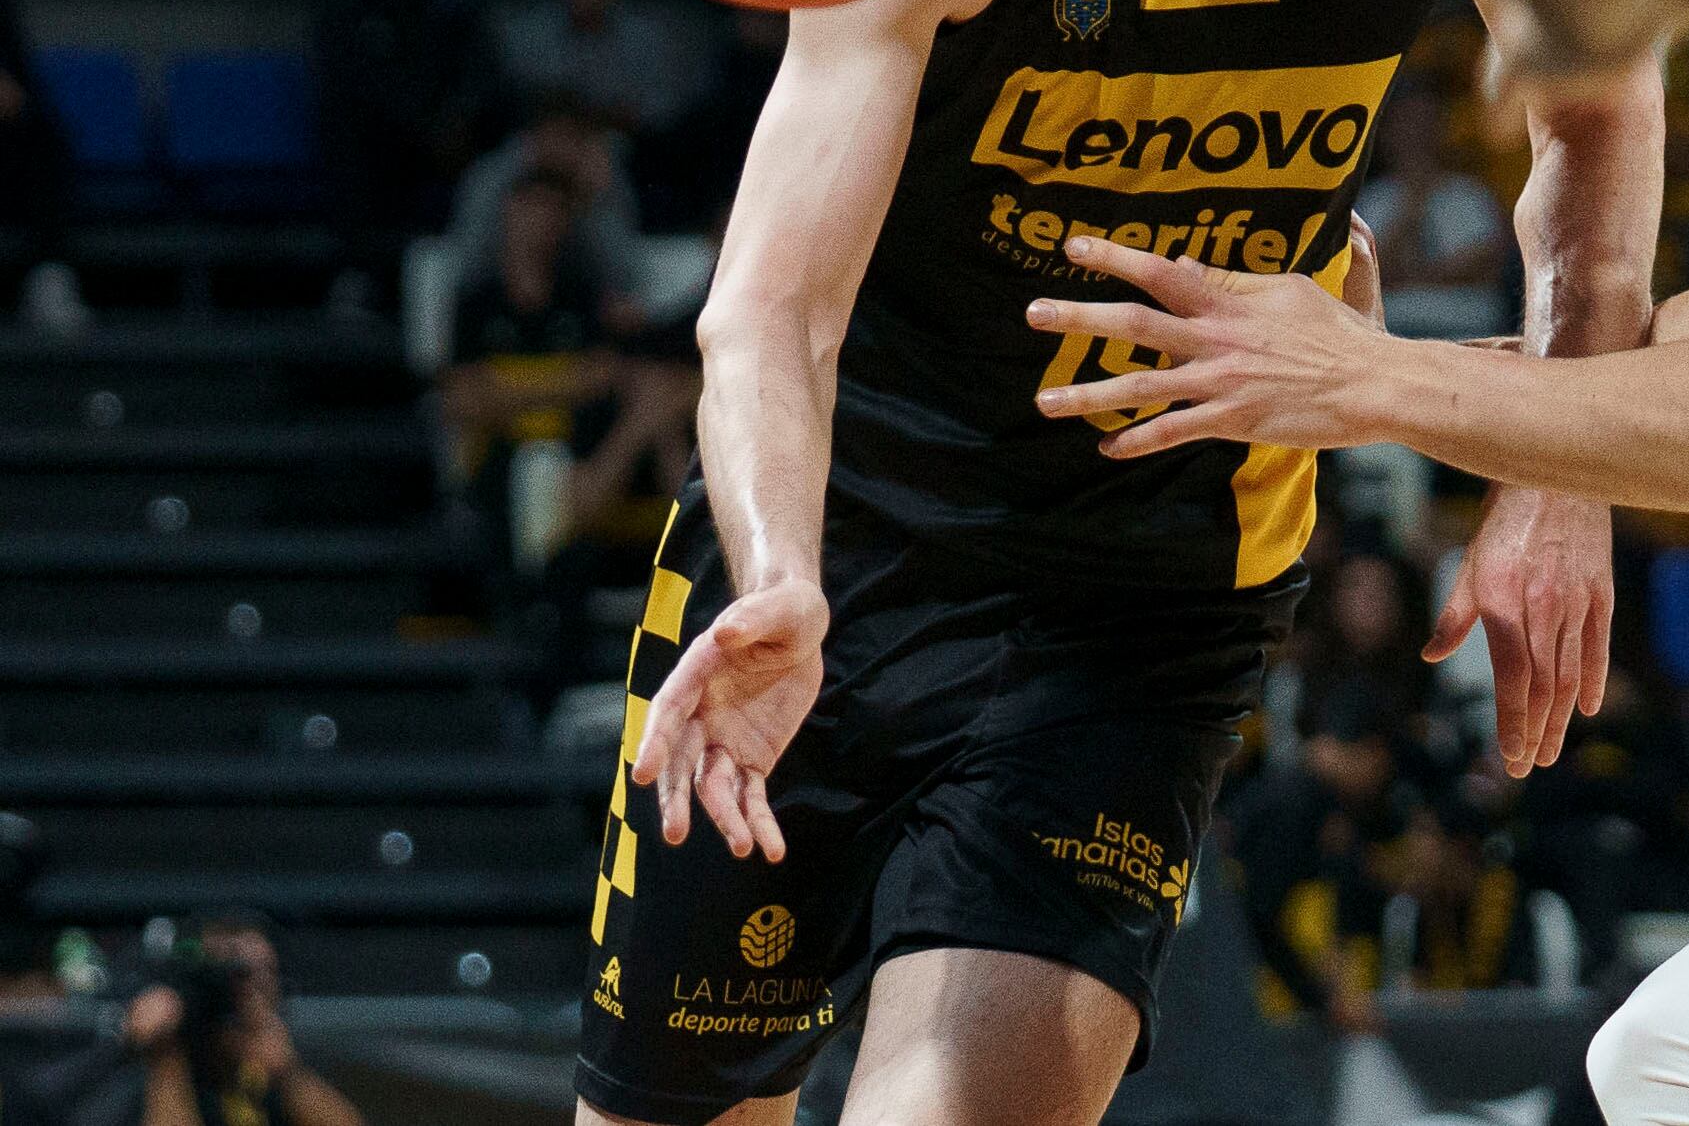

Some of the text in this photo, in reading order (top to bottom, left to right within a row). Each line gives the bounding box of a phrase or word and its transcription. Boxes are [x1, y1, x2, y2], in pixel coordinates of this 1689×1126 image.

[997, 88, 1369, 174] Lenovo
[1094, 811, 1164, 867] Islas
[673, 973, 833, 1005] LA LAGUNA
[667, 1003, 834, 1037] deporte para ti
